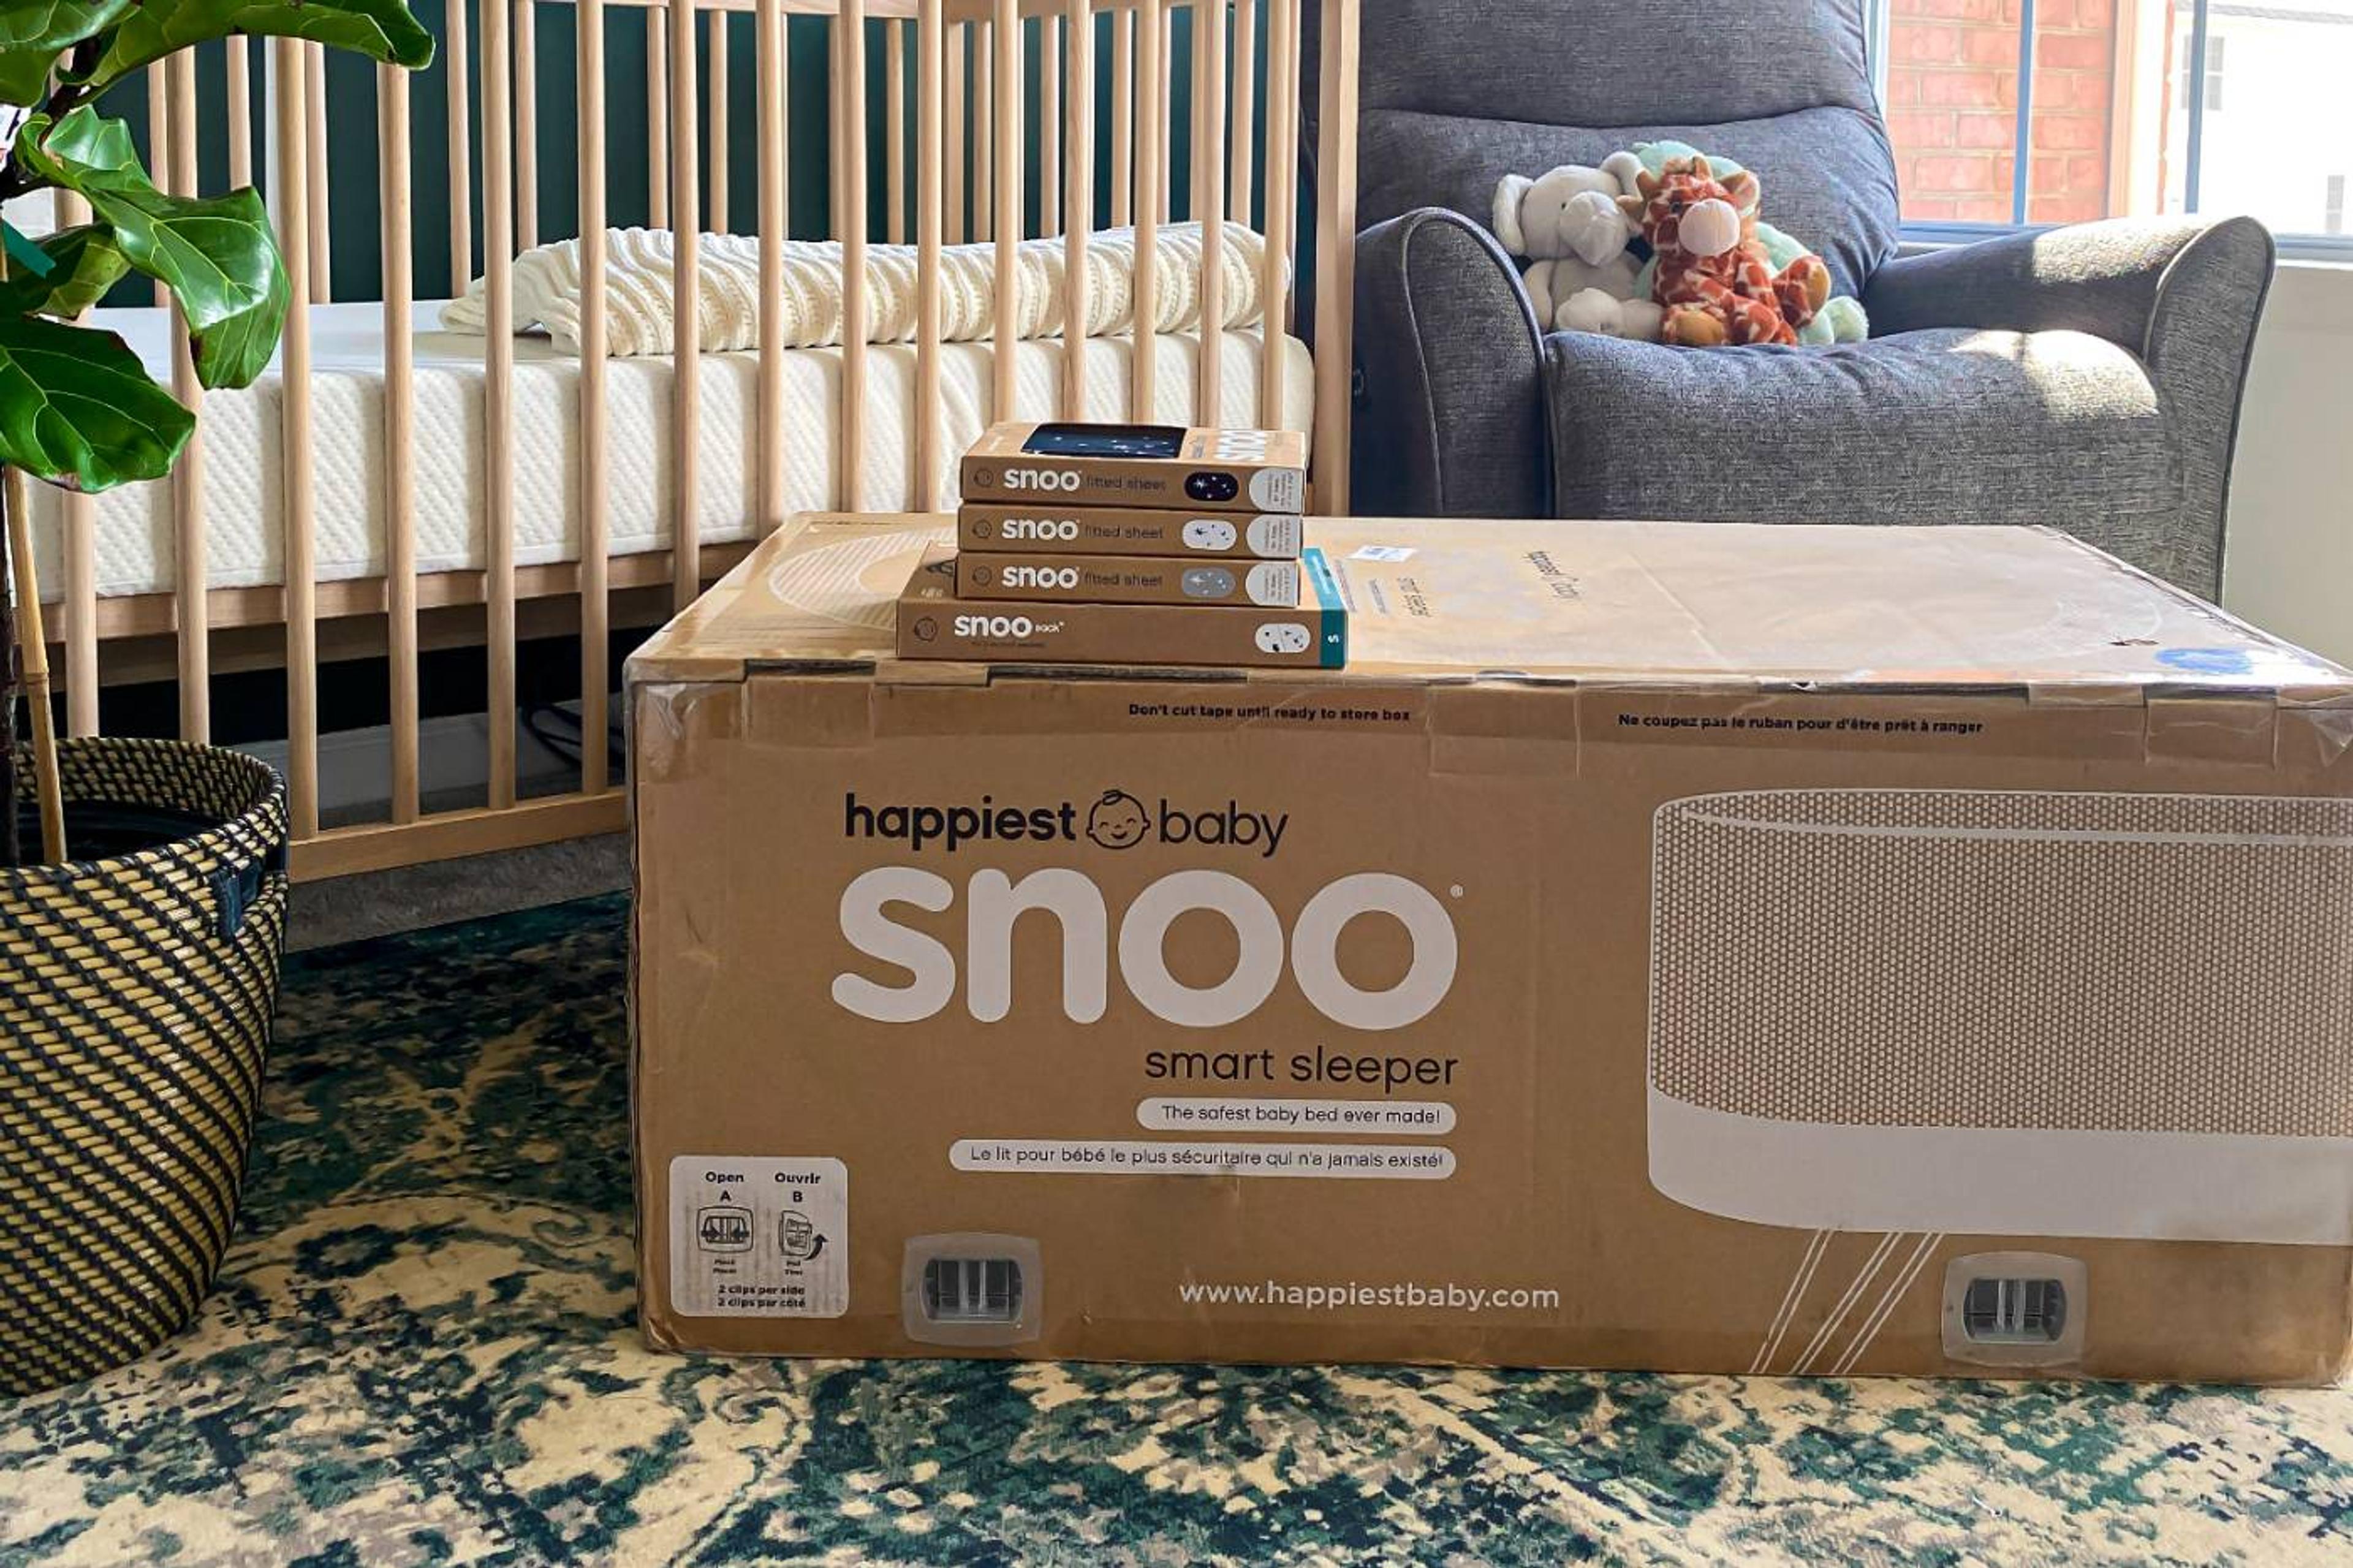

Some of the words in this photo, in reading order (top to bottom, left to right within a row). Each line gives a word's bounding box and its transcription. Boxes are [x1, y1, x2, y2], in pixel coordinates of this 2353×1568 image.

[1004, 469, 1080, 491] snoo
[1086, 475, 1122, 488] fitted
[1002, 519, 1078, 540] snoo
[1085, 525, 1120, 538] fitted
[1125, 526, 1163, 539] sheet
[1002, 566, 1078, 589] snoo
[1085, 572, 1120, 585] fitted
[1124, 574, 1162, 587] sheet
[954, 615, 1033, 638] snoo
[1129, 703, 1169, 716] Don't
[1172, 705, 1196, 716] cut
[1200, 705, 1233, 719] tape
[1237, 706, 1271, 718] until
[1275, 707, 1316, 721] ready
[1321, 708, 1336, 719] to
[1341, 708, 1378, 720] store
[1382, 708, 1410, 721] box
[1618, 714, 1639, 727] Ne
[1643, 716, 1697, 730] coupez
[1701, 718, 1727, 730] pas
[1732, 716, 1746, 729] le
[1749, 717, 1792, 729] ruban
[1797, 719, 1832, 732] pour
[1920, 719, 1930, 732] à
[1933, 721, 1983, 735] ranger
[846, 793, 1077, 851] happiest
[1159, 799, 1289, 858] baby
[832, 866, 1458, 1031] snoo
[1145, 1047, 1274, 1082] smart
[1289, 1045, 1458, 1093] sleeper
[1162, 1105, 1194, 1121] The
[1198, 1105, 1251, 1122] safest
[1256, 1107, 1299, 1124] baby
[1305, 1108, 1338, 1123] bed
[1344, 1110, 1381, 1123] ever
[1385, 1109, 1441, 1124] made!
[971, 1146, 991, 1161] Le
[996, 1146, 1012, 1161] lit
[1016, 1149, 1055, 1165] pour
[1061, 1147, 1105, 1162] bébé
[1110, 1148, 1126, 1163] le
[1131, 1148, 1167, 1165] plus
[1172, 1148, 1262, 1165] sécuritaire
[1265, 1151, 1292, 1167] qui
[1298, 1150, 1322, 1165] n'a
[1327, 1152, 1384, 1170] jamais
[1388, 1153, 1444, 1168] existé!
[706, 1172, 744, 1183] Open
[775, 1173, 821, 1184] Ouvrir
[719, 1190, 732, 1202] A
[793, 1191, 803, 1202] B
[718, 1284, 726, 1293] 2
[728, 1284, 756, 1295] clips
[758, 1287, 778, 1295] per
[1180, 1280, 1559, 1312] www.happiestbaby.com
[718, 1298, 725, 1306] 2
[727, 1298, 755, 1308] clips
